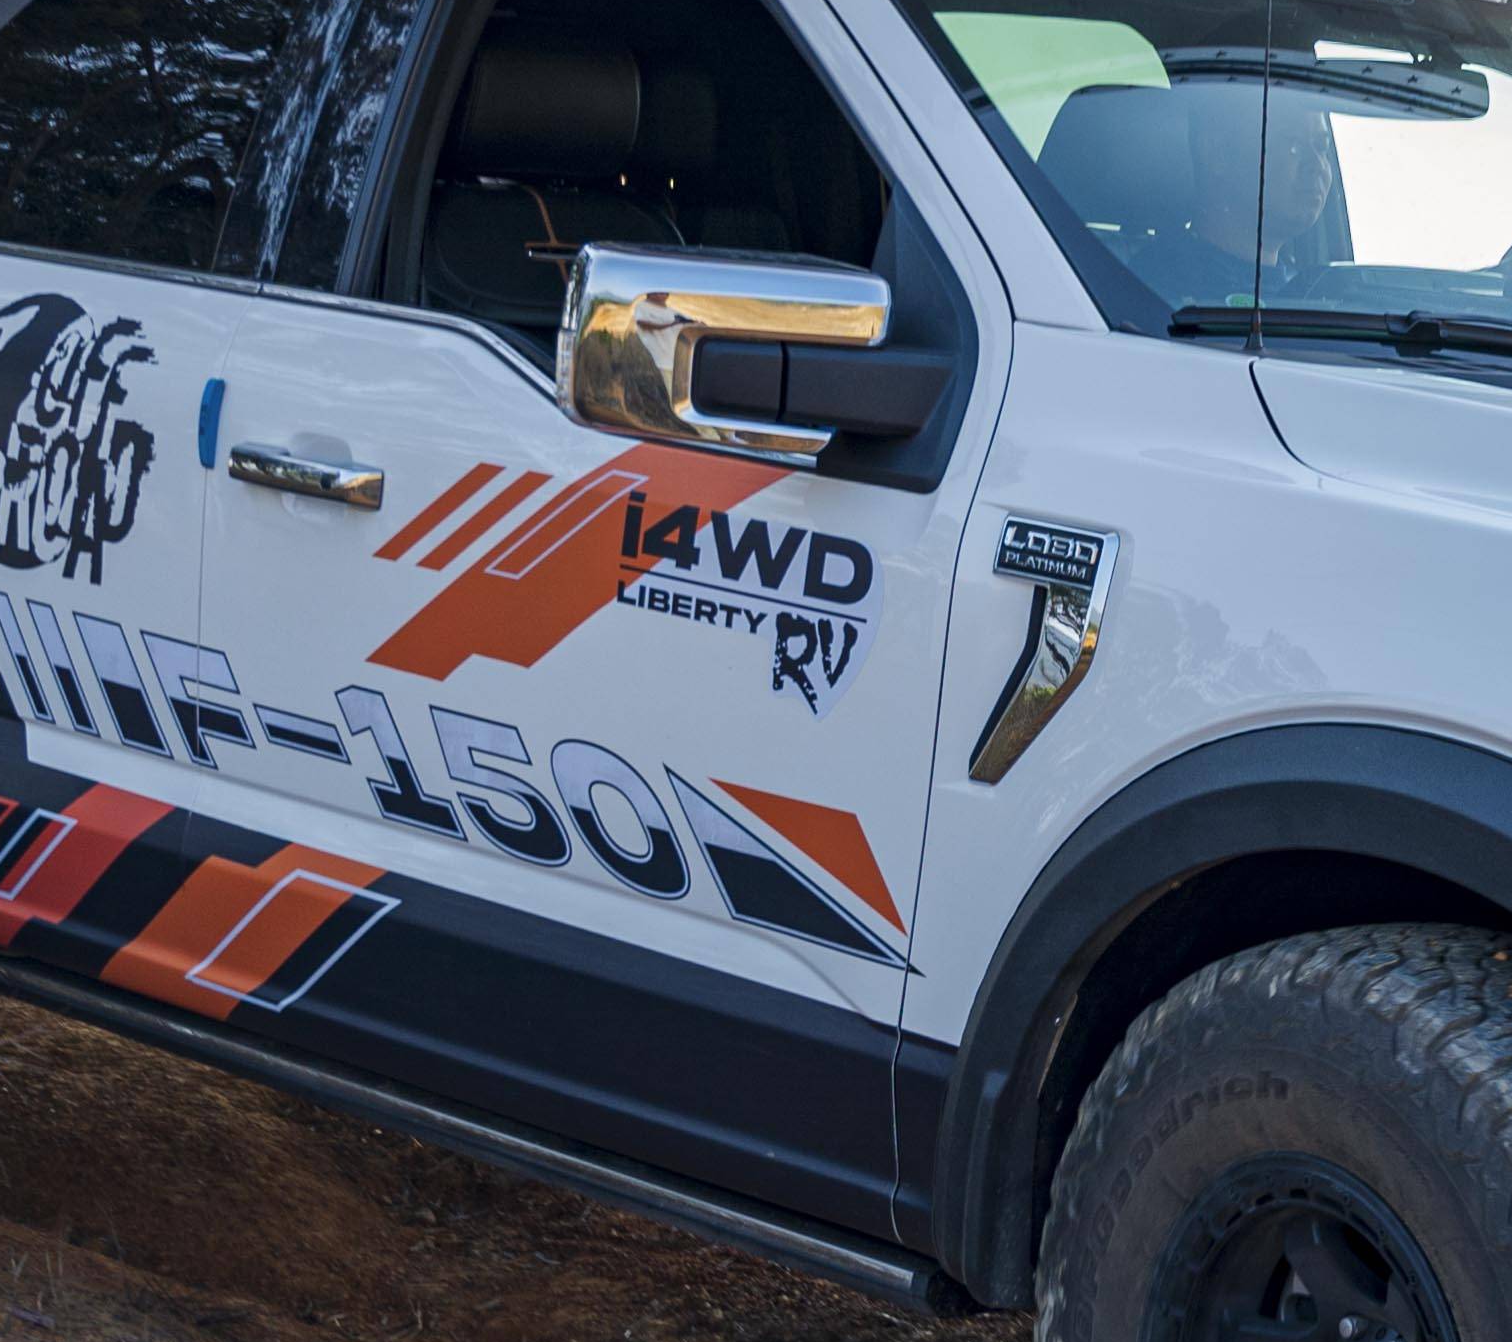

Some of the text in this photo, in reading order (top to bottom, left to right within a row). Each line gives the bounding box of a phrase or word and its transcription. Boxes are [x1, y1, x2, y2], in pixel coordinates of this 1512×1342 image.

[621, 490, 874, 605] i4WD
[1004, 525, 1099, 565] LOBO
[1005, 551, 1087, 579] PLATINUM
[617, 580, 858, 715] LIBERTY RV
[139, 629, 691, 900] F-150
